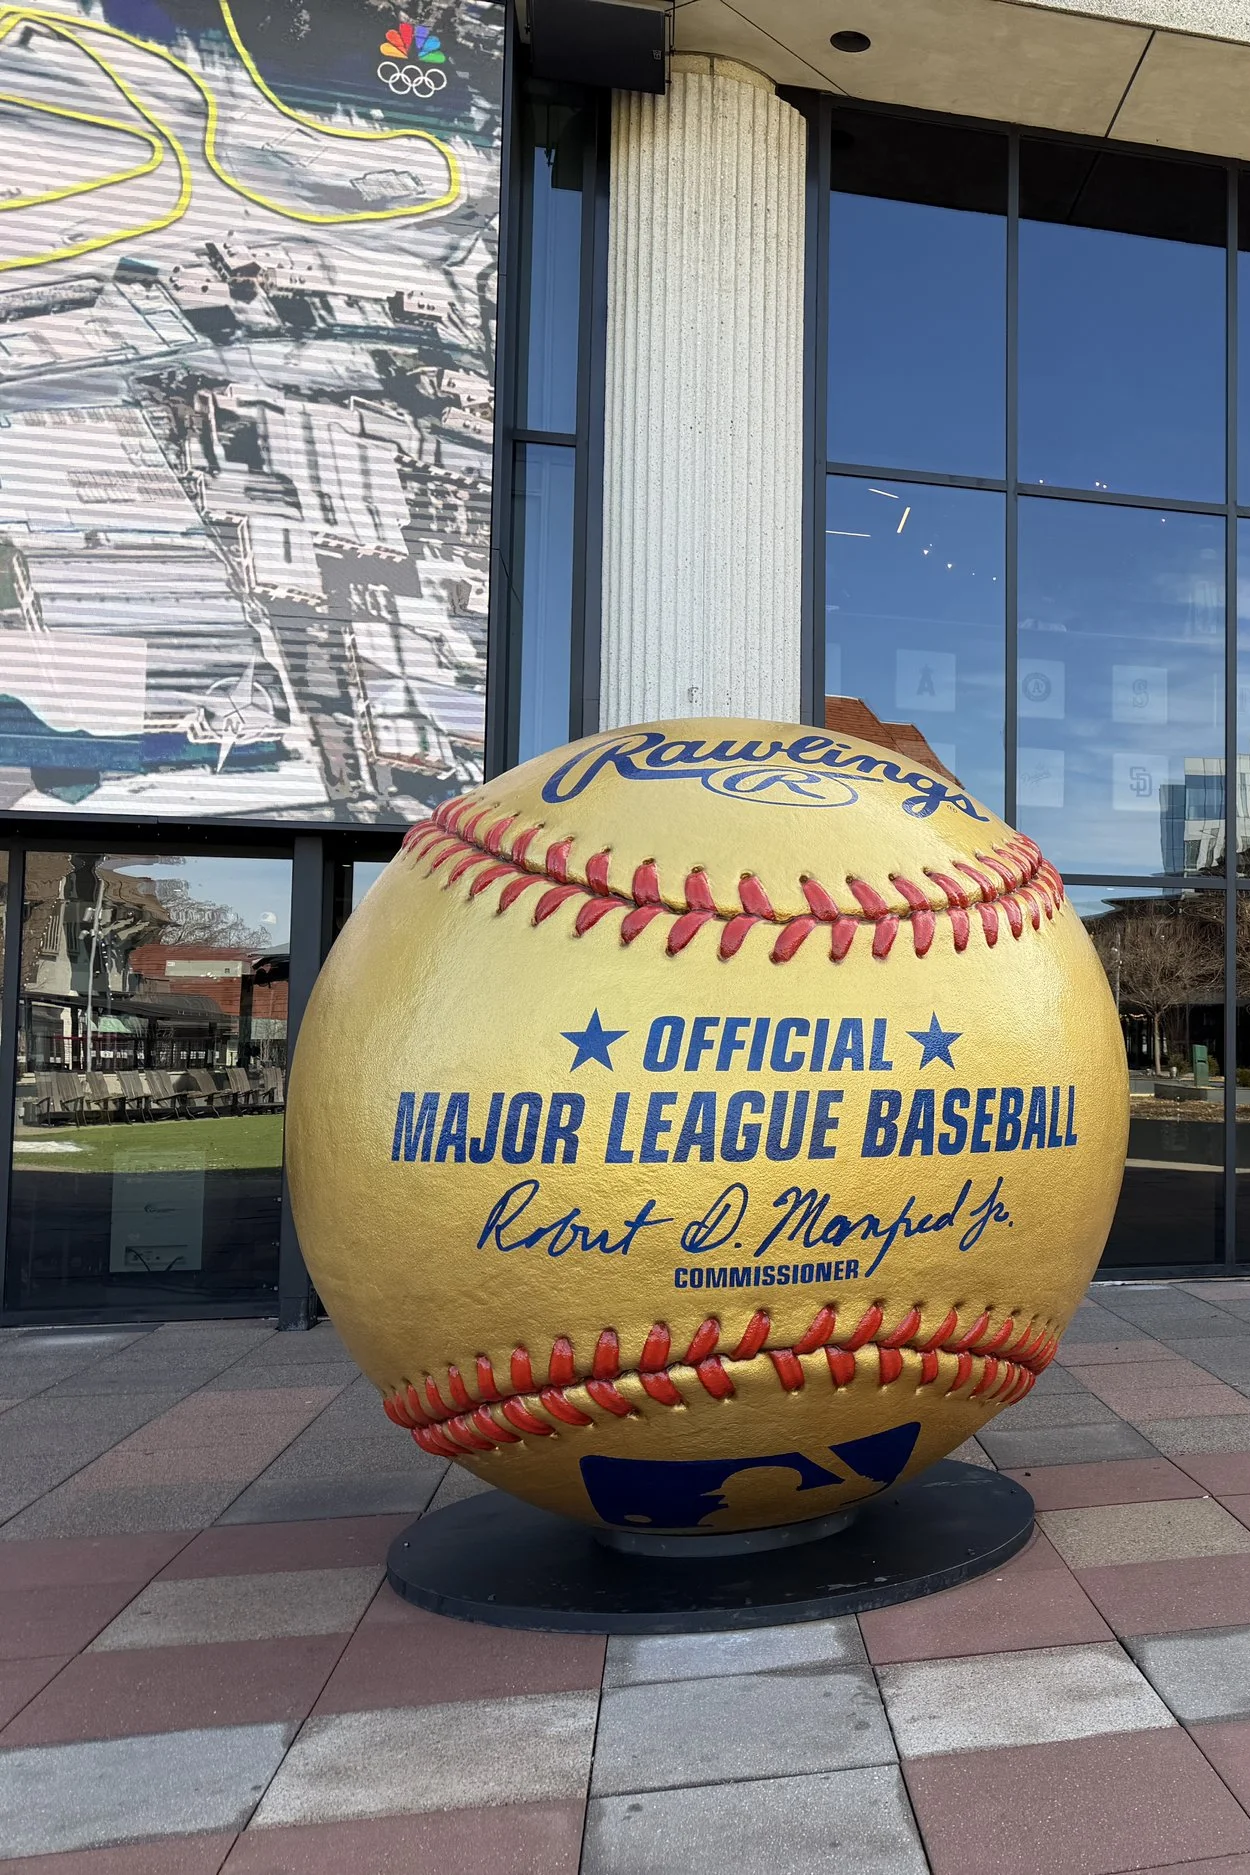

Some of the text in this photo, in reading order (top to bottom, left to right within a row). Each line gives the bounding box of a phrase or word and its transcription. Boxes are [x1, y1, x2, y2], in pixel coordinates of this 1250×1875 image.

[541, 730, 990, 824] Rawlings
[643, 1016, 893, 1073] OFFICIAL
[391, 1085, 1079, 1165] MAJOR LEAGUE BASEBALL
[673, 1259, 861, 1290] COMMISSIONER
